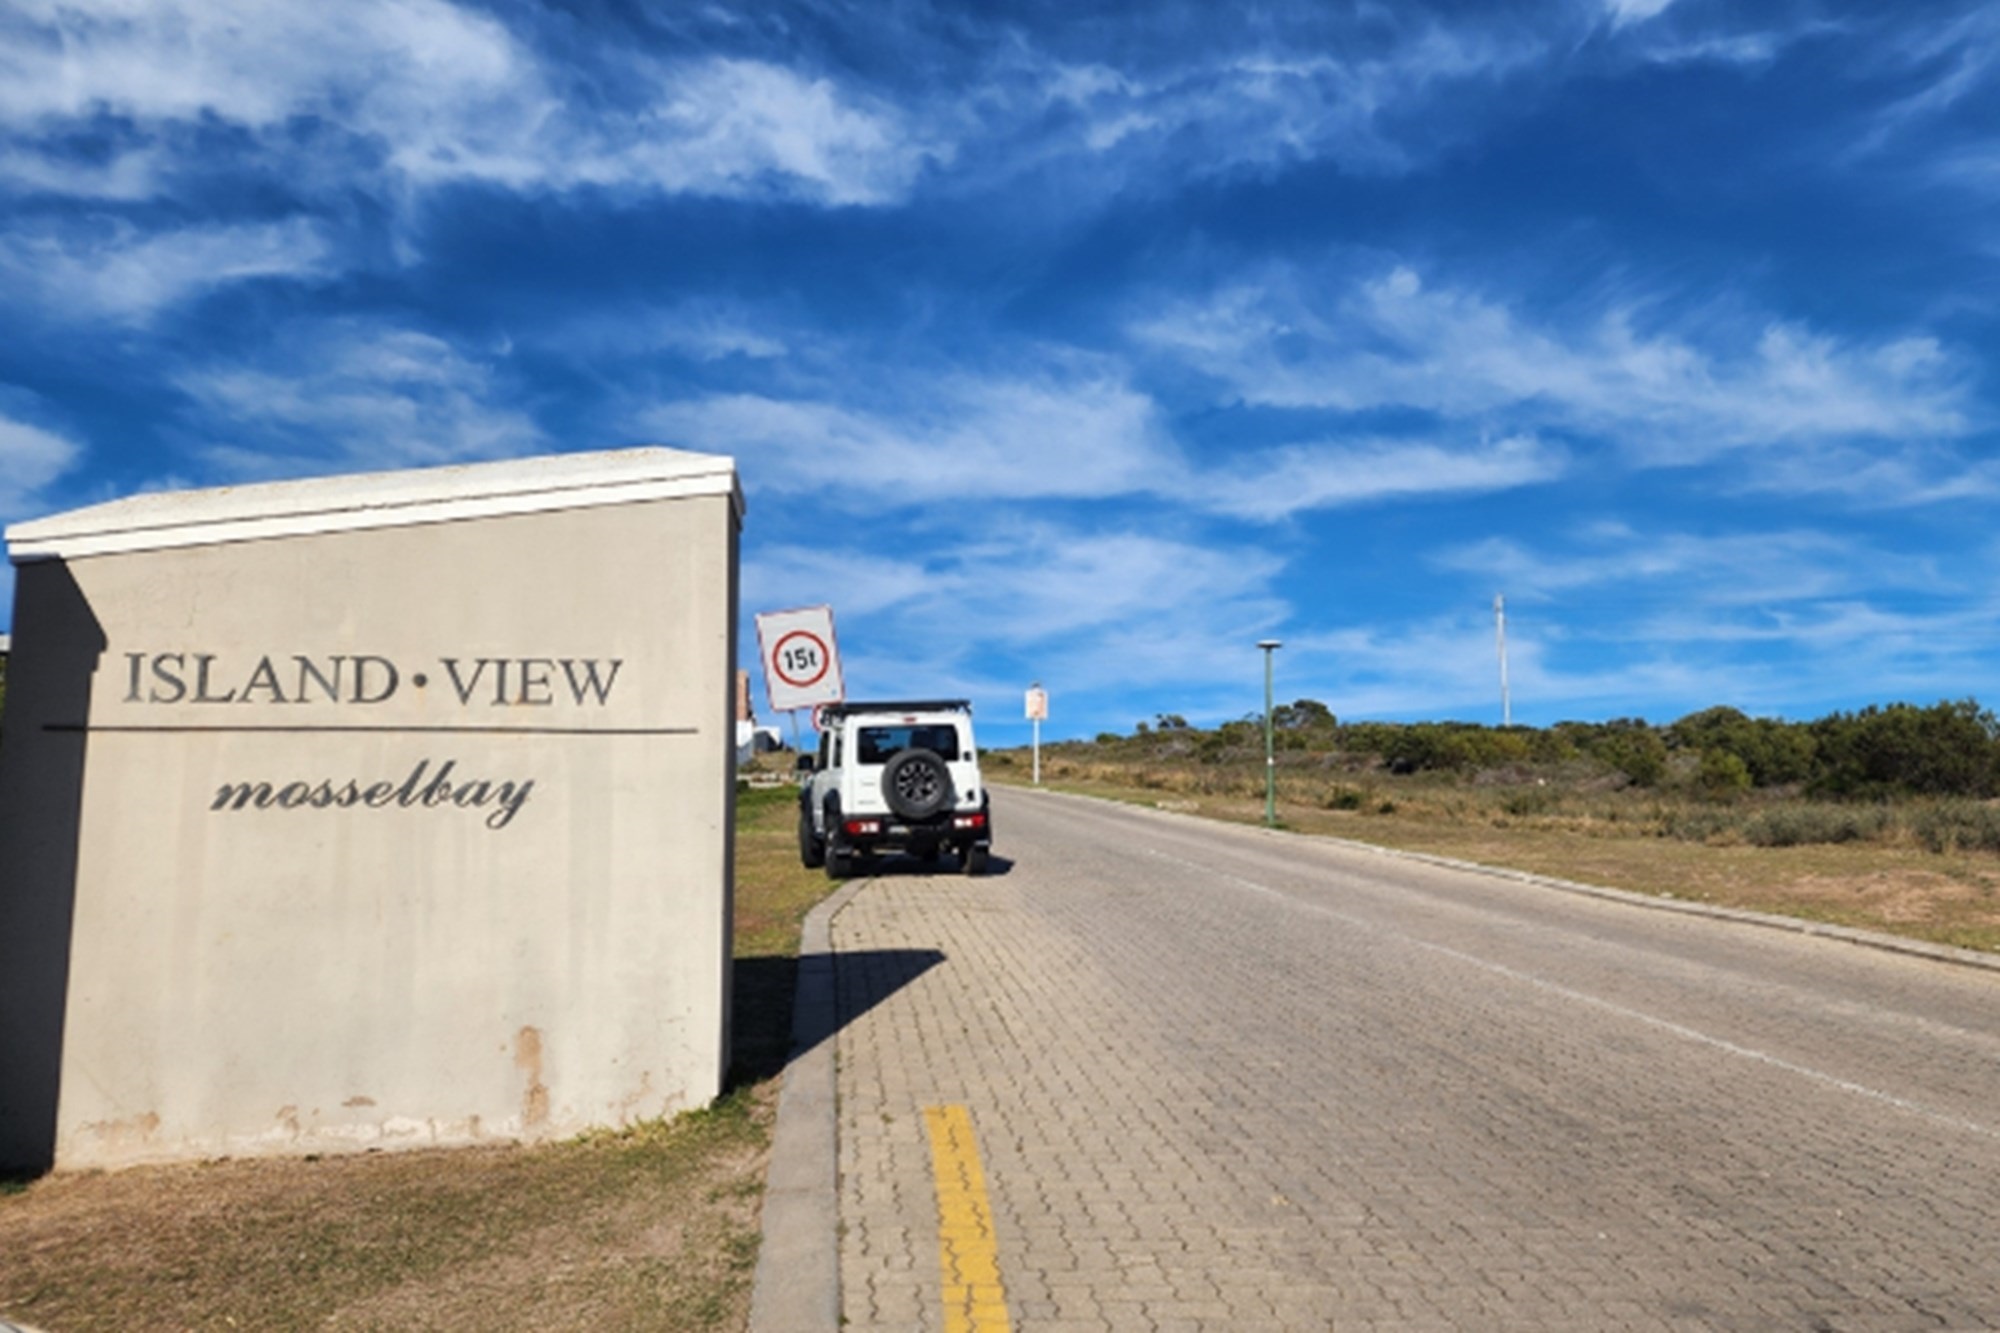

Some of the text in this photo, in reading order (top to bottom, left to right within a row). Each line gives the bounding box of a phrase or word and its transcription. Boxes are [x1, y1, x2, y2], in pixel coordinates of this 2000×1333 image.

[123, 652, 623, 706] ISLAND VIEW
[784, 647, 817, 670] 15t
[209, 759, 535, 829] mosselbay
